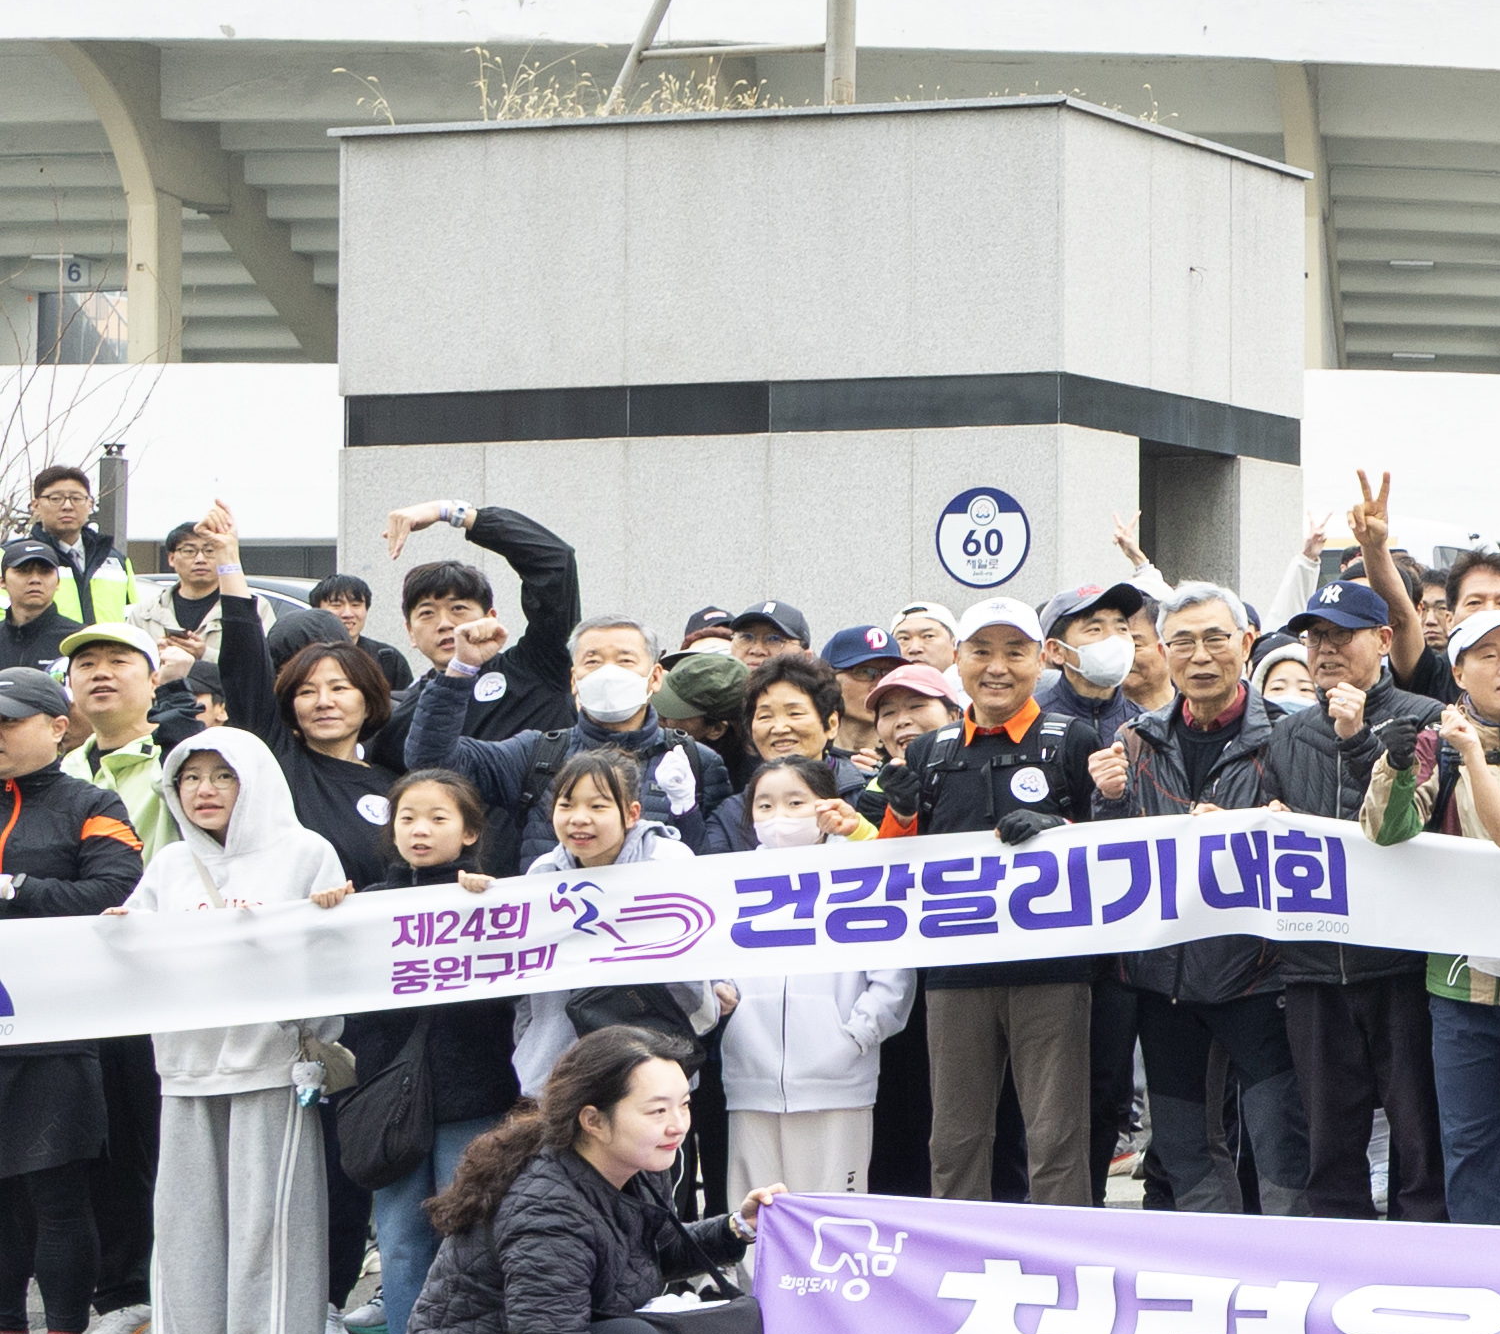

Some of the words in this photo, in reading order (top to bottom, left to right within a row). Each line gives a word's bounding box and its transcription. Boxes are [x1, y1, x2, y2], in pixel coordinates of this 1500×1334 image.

[68, 262, 81, 282] 6
[962, 528, 1004, 557] 60
[730, 837, 1179, 949] 건강달리기
[1198, 829, 1349, 916] 대회
[391, 901, 531, 948] 제24회
[1276, 918, 1314, 933] Since
[1316, 920, 1350, 935] 2000
[391, 942, 559, 995] 중원구민
